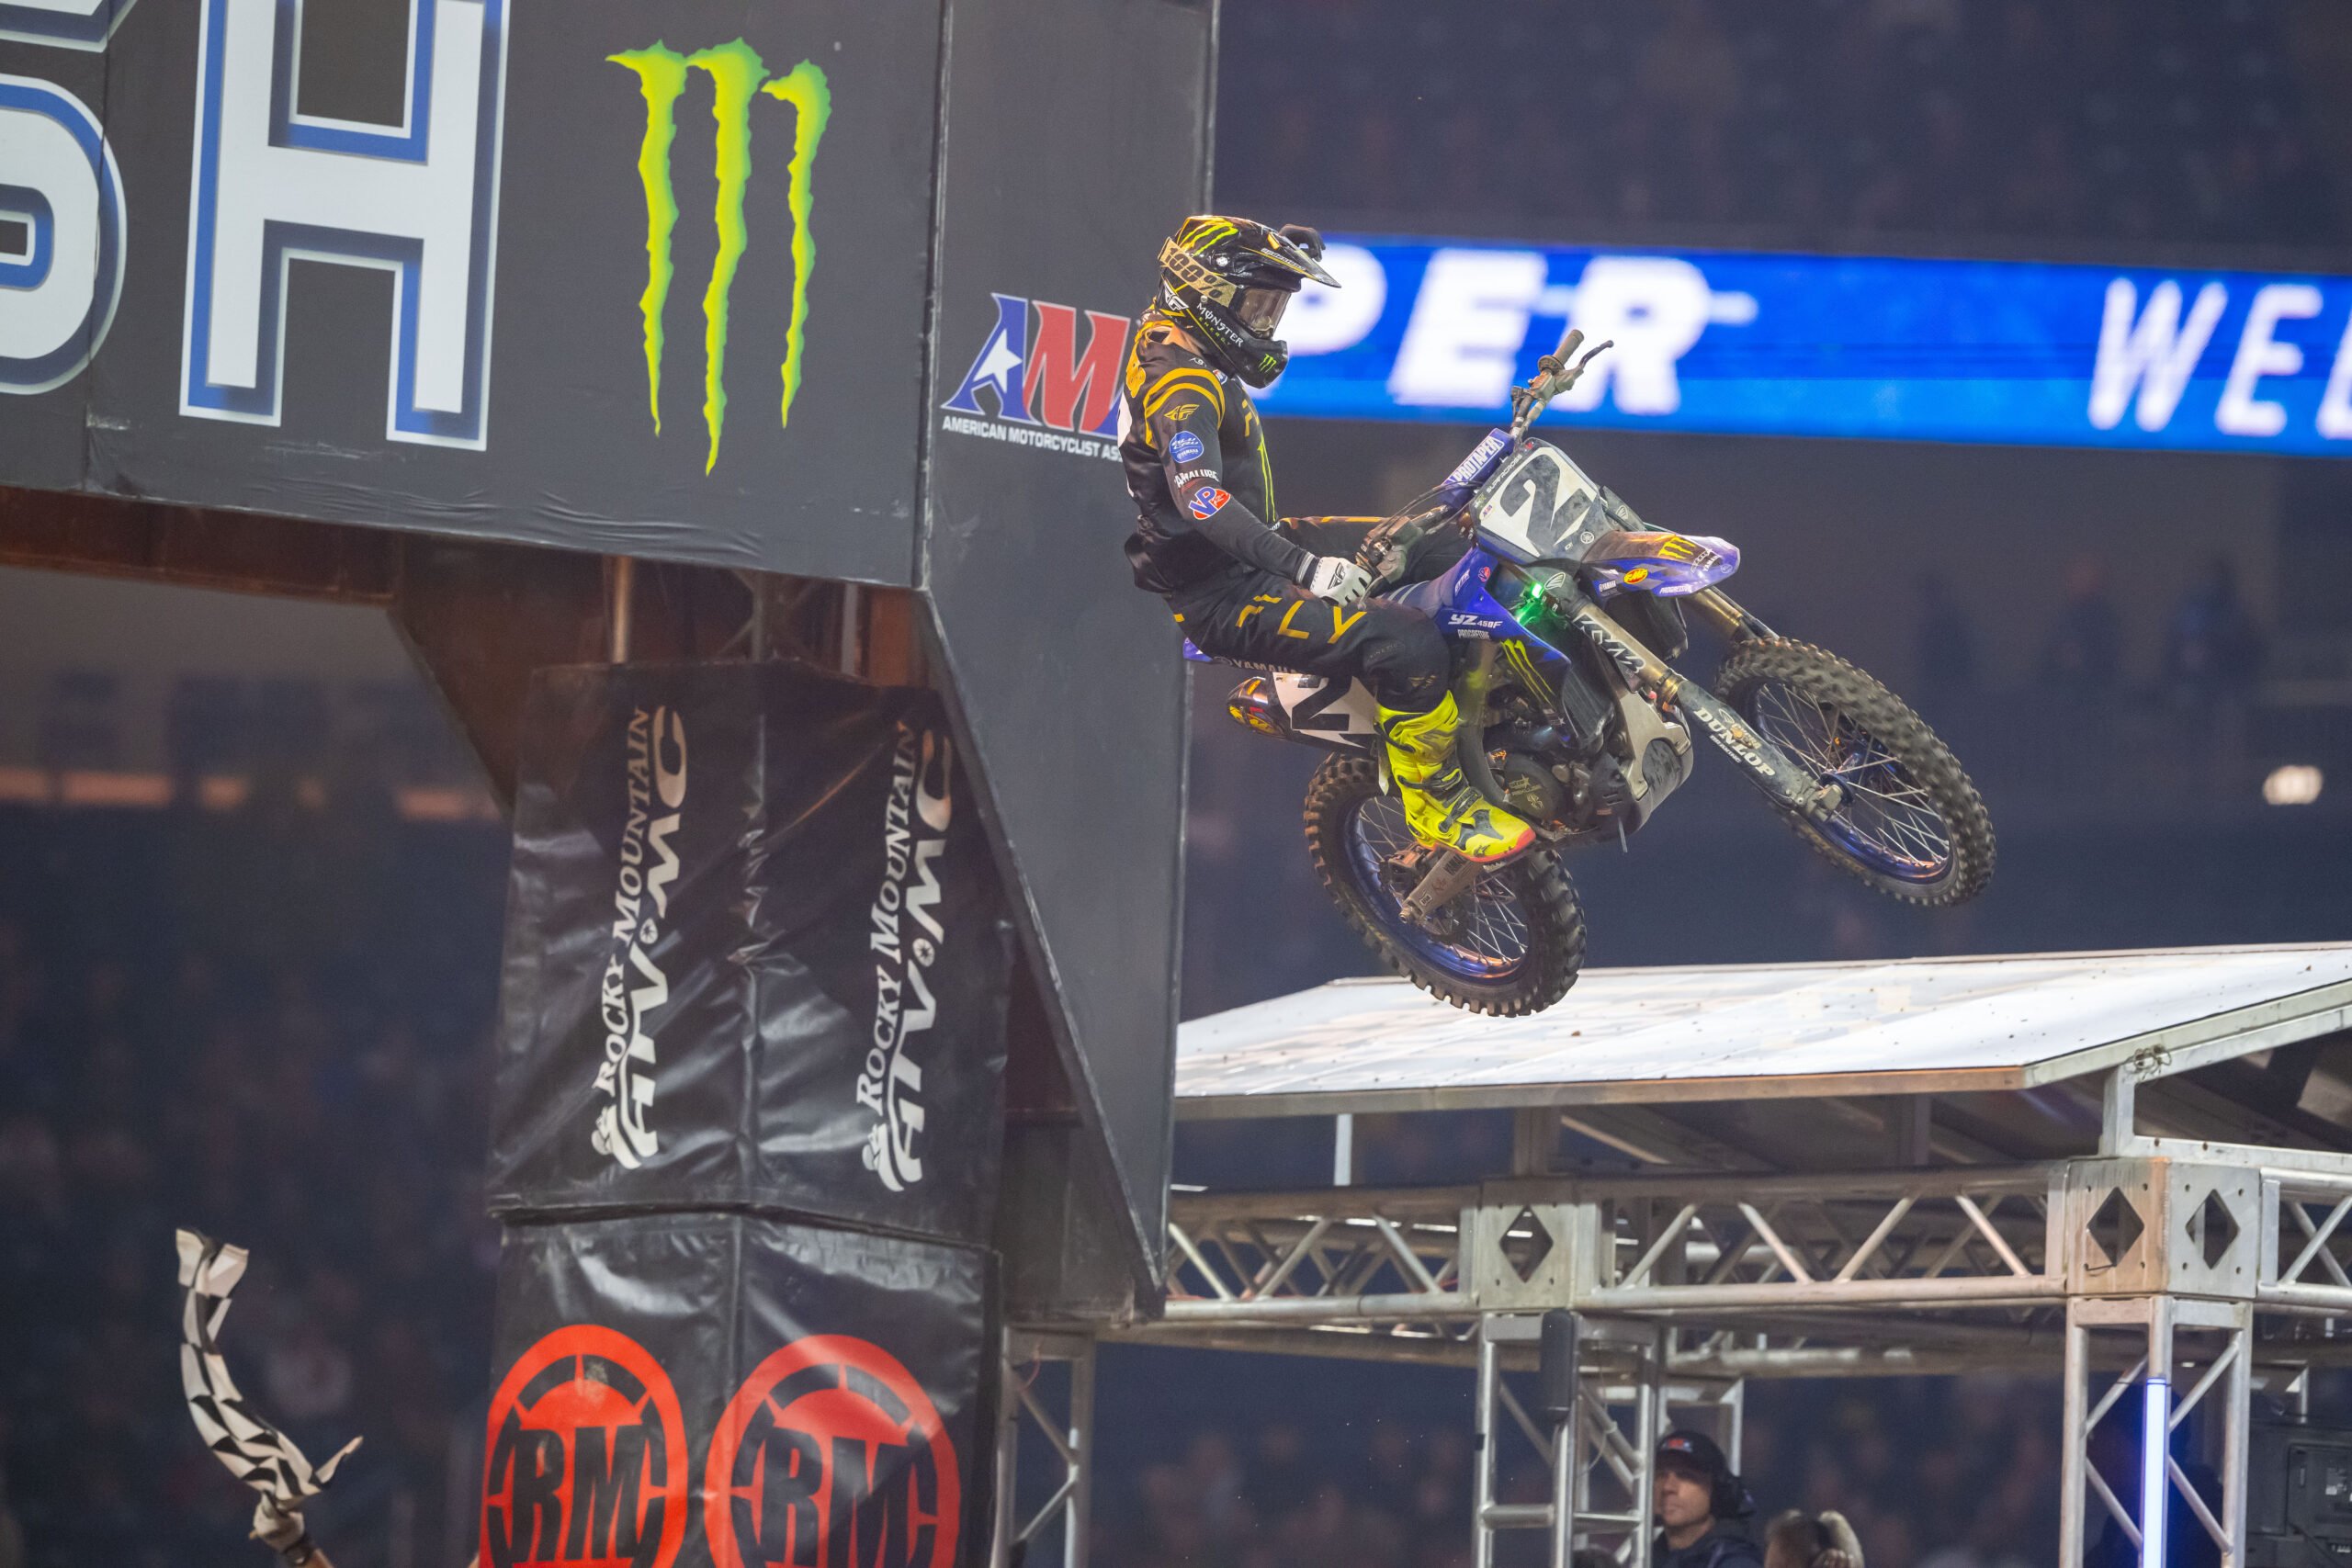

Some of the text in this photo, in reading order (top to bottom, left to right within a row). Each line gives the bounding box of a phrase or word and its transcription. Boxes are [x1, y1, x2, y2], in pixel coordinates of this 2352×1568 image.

[1196, 302, 1244, 347] MONSTER
[942, 415, 1008, 442] AMERICAN
[1008, 427, 1102, 457] MOTORCYCLIST
[1453, 436, 1502, 485] PROTAPER
[1693, 706, 1776, 776] DUNLOP
[592, 706, 650, 1096] ROCKY MOUNTAIN
[856, 719, 916, 1116] ROCKY MOUNTAIN
